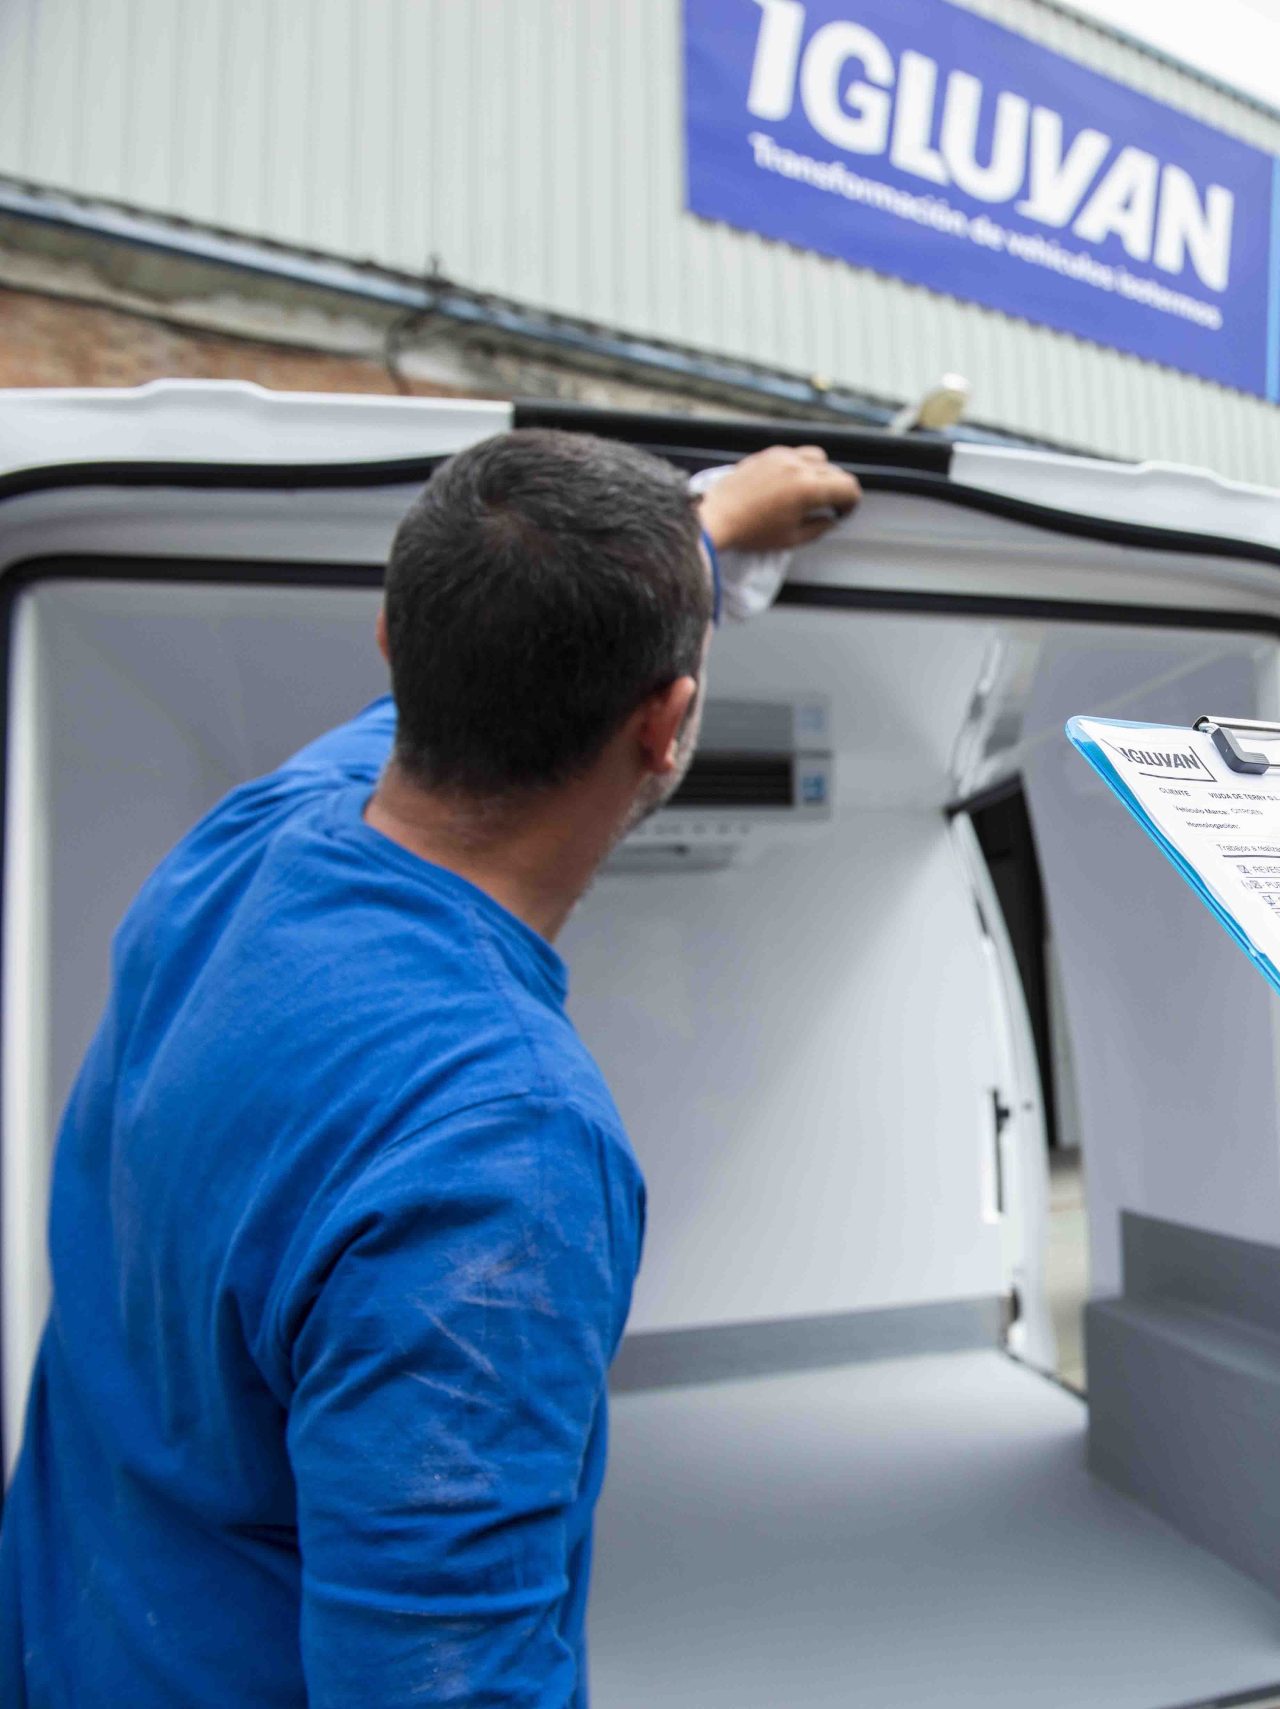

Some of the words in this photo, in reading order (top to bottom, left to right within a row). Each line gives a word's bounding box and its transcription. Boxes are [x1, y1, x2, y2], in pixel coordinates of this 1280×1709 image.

[746, 0, 1235, 292] IGLUVAN
[1119, 747, 1201, 770] IGLUVAN
[1158, 787, 1192, 797] CLIENTE
[1208, 791, 1233, 800] VIUDA
